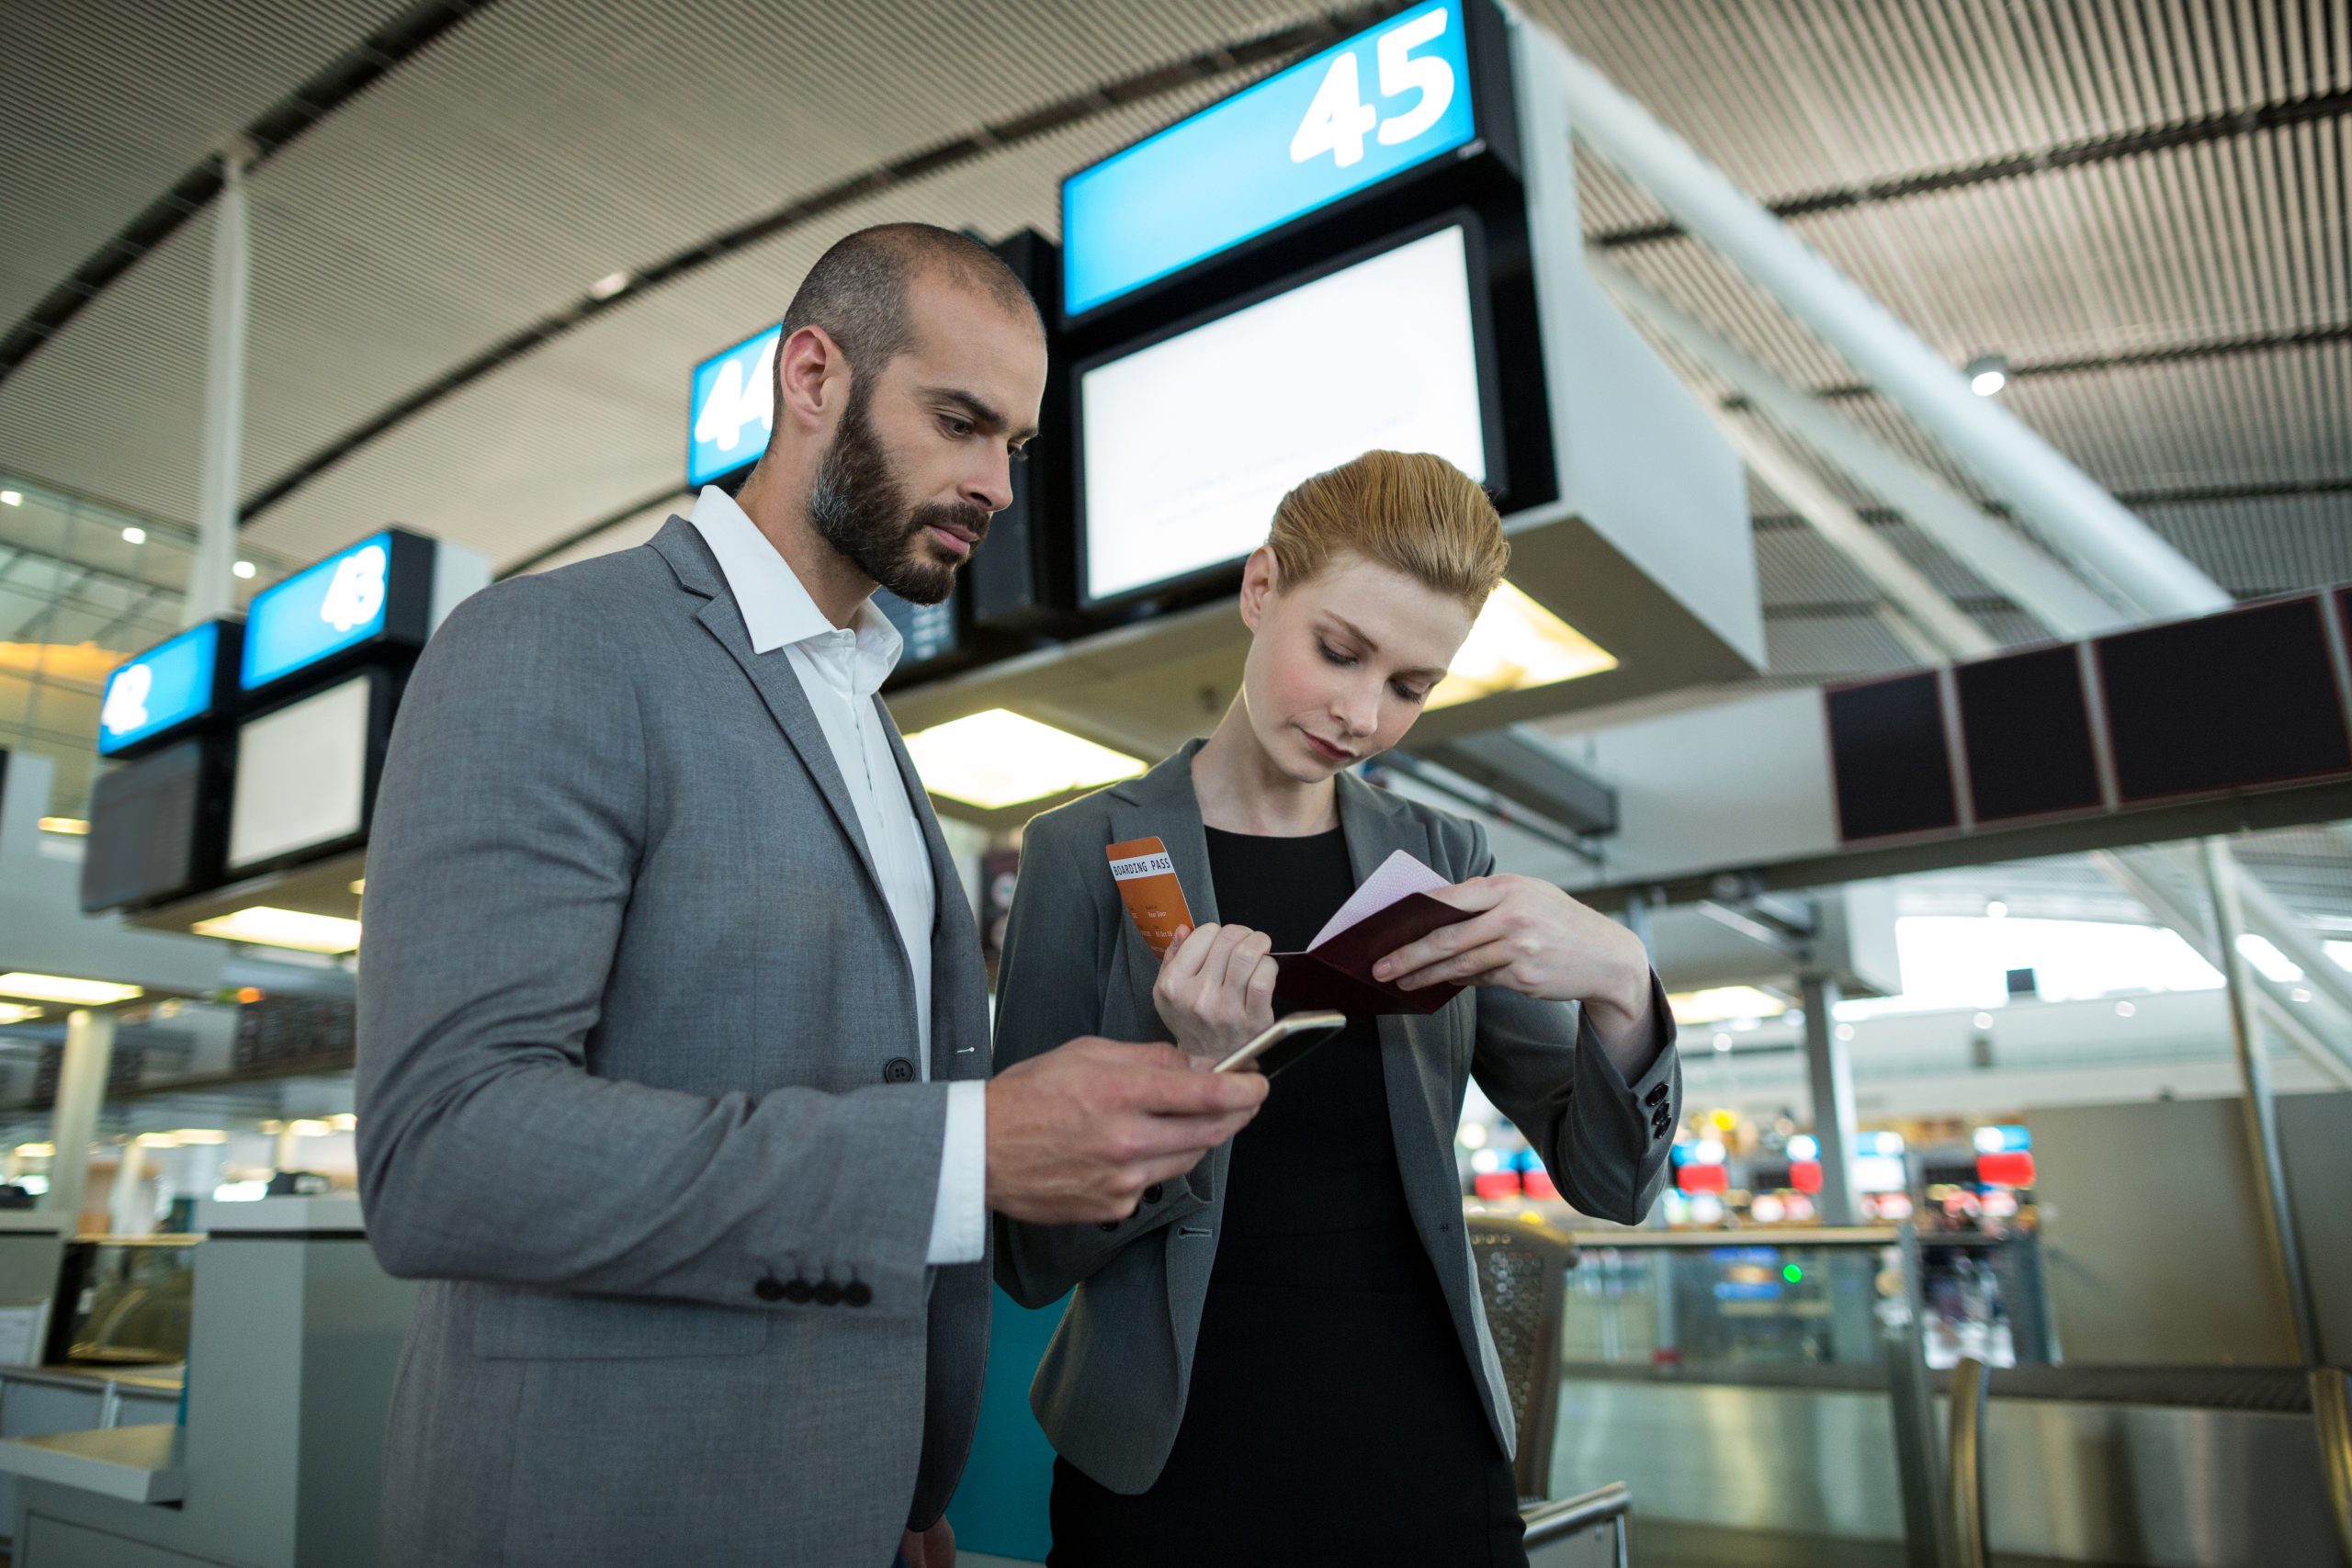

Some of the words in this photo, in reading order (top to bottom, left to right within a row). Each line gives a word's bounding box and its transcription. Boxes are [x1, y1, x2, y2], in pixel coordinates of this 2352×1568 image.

[1290, 6, 1454, 168] 45
[320, 545, 386, 632] 43
[1113, 862, 1148, 876] BOARDING
[1150, 857, 1170, 871] PASS
